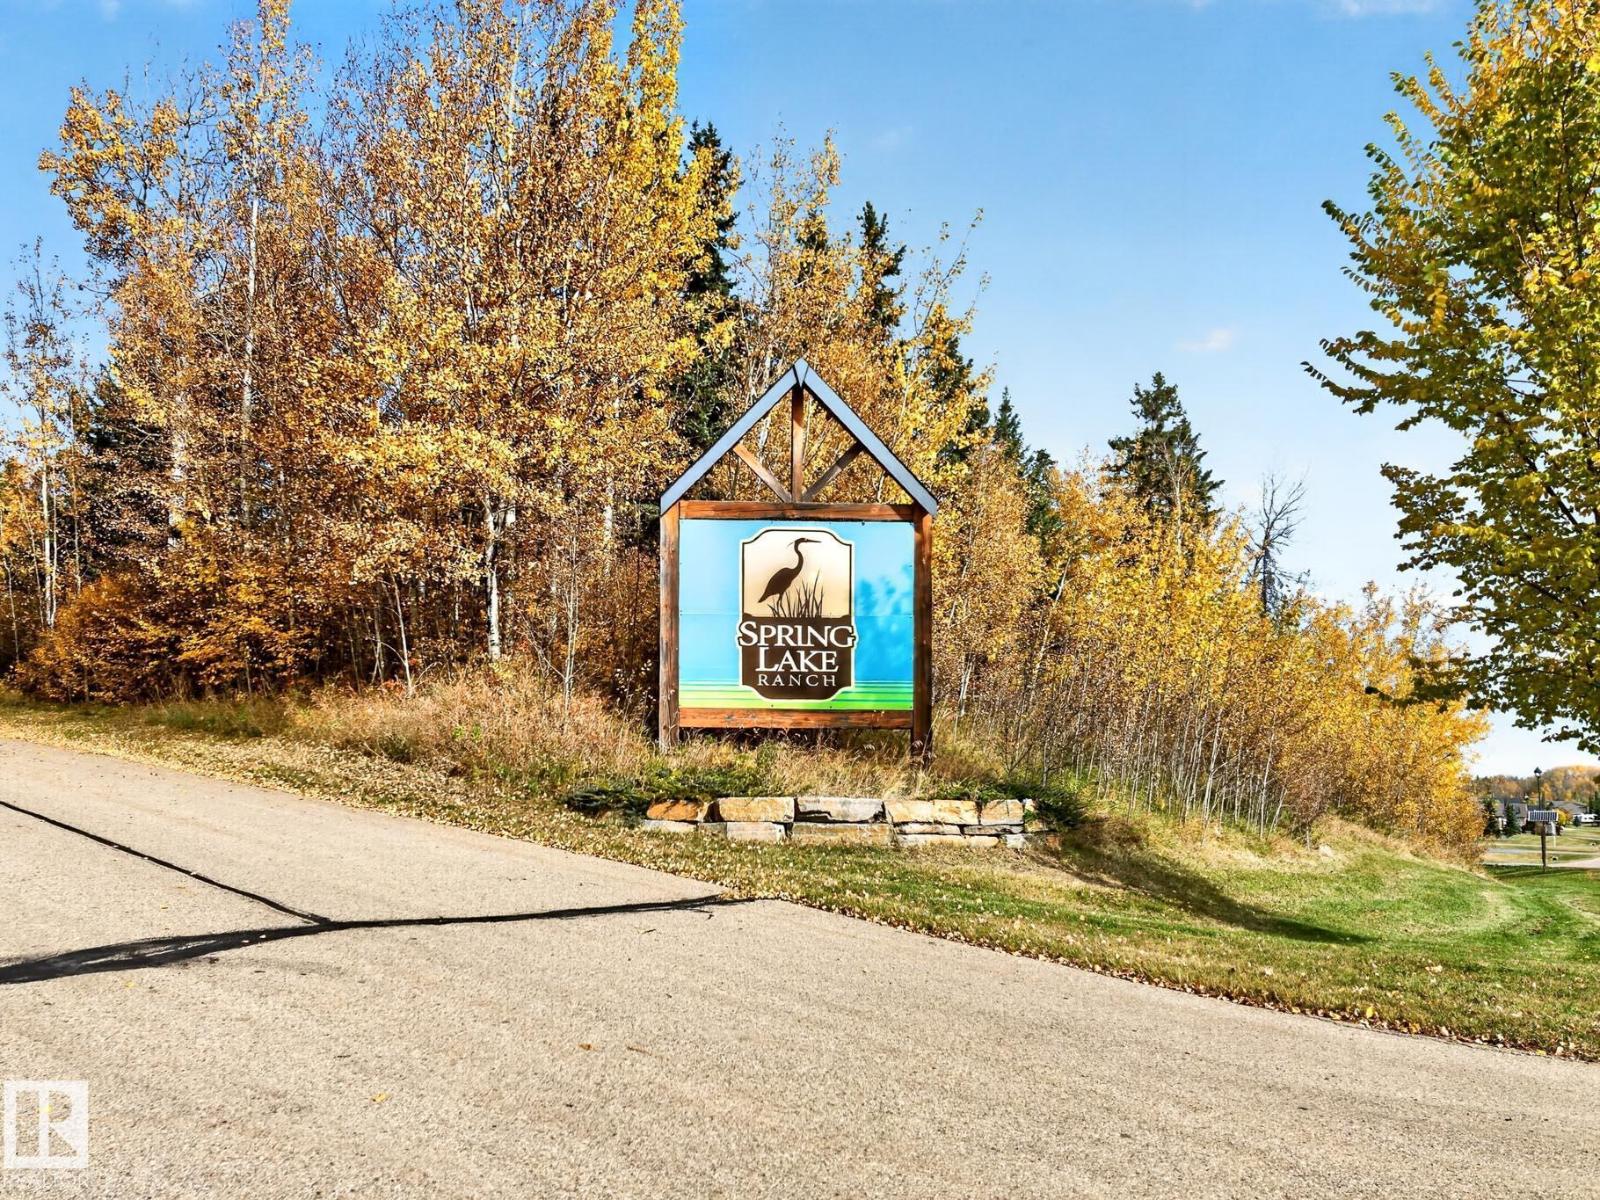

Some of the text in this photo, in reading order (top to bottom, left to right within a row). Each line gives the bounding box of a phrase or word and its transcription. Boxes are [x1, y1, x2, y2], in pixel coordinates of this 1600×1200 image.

[739, 621, 854, 647] SPRING
[755, 646, 839, 672] LAKE
[757, 673, 836, 687] RANCH
